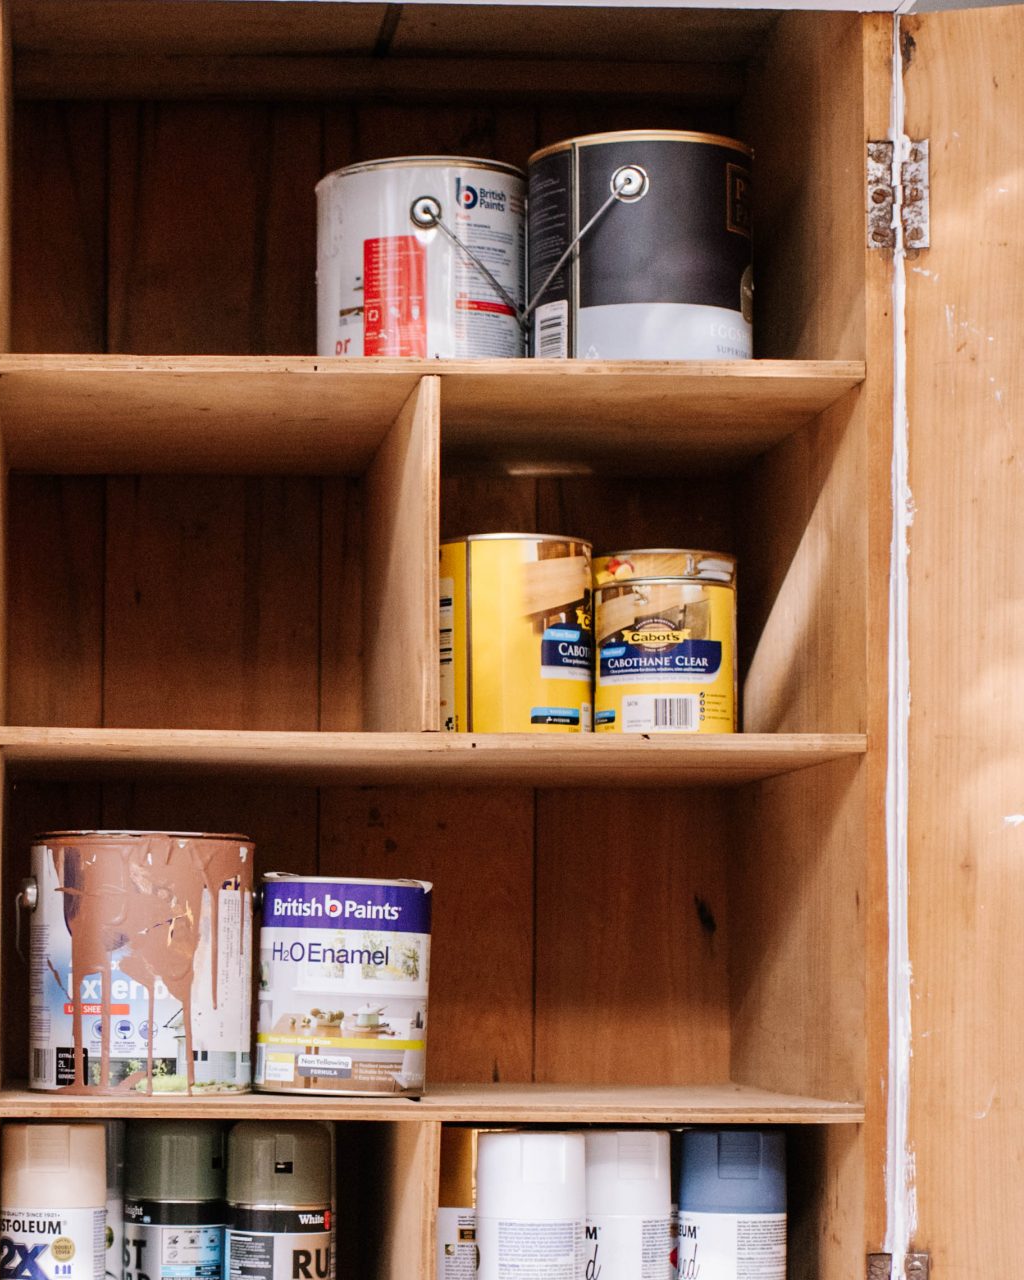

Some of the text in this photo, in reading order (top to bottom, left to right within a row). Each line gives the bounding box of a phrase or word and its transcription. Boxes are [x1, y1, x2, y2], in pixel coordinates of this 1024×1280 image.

[479, 188, 506, 201] British
[479, 200, 505, 212] Paints
[631, 632, 680, 642] Cabot's
[675, 656, 708, 666] CLEAR
[274, 898, 322, 917] British
[345, 900, 399, 920] Paints
[58, 1060, 66, 1068] 2L
[316, 1059, 349, 1067] Yellowing
[298, 1214, 324, 1224] White
